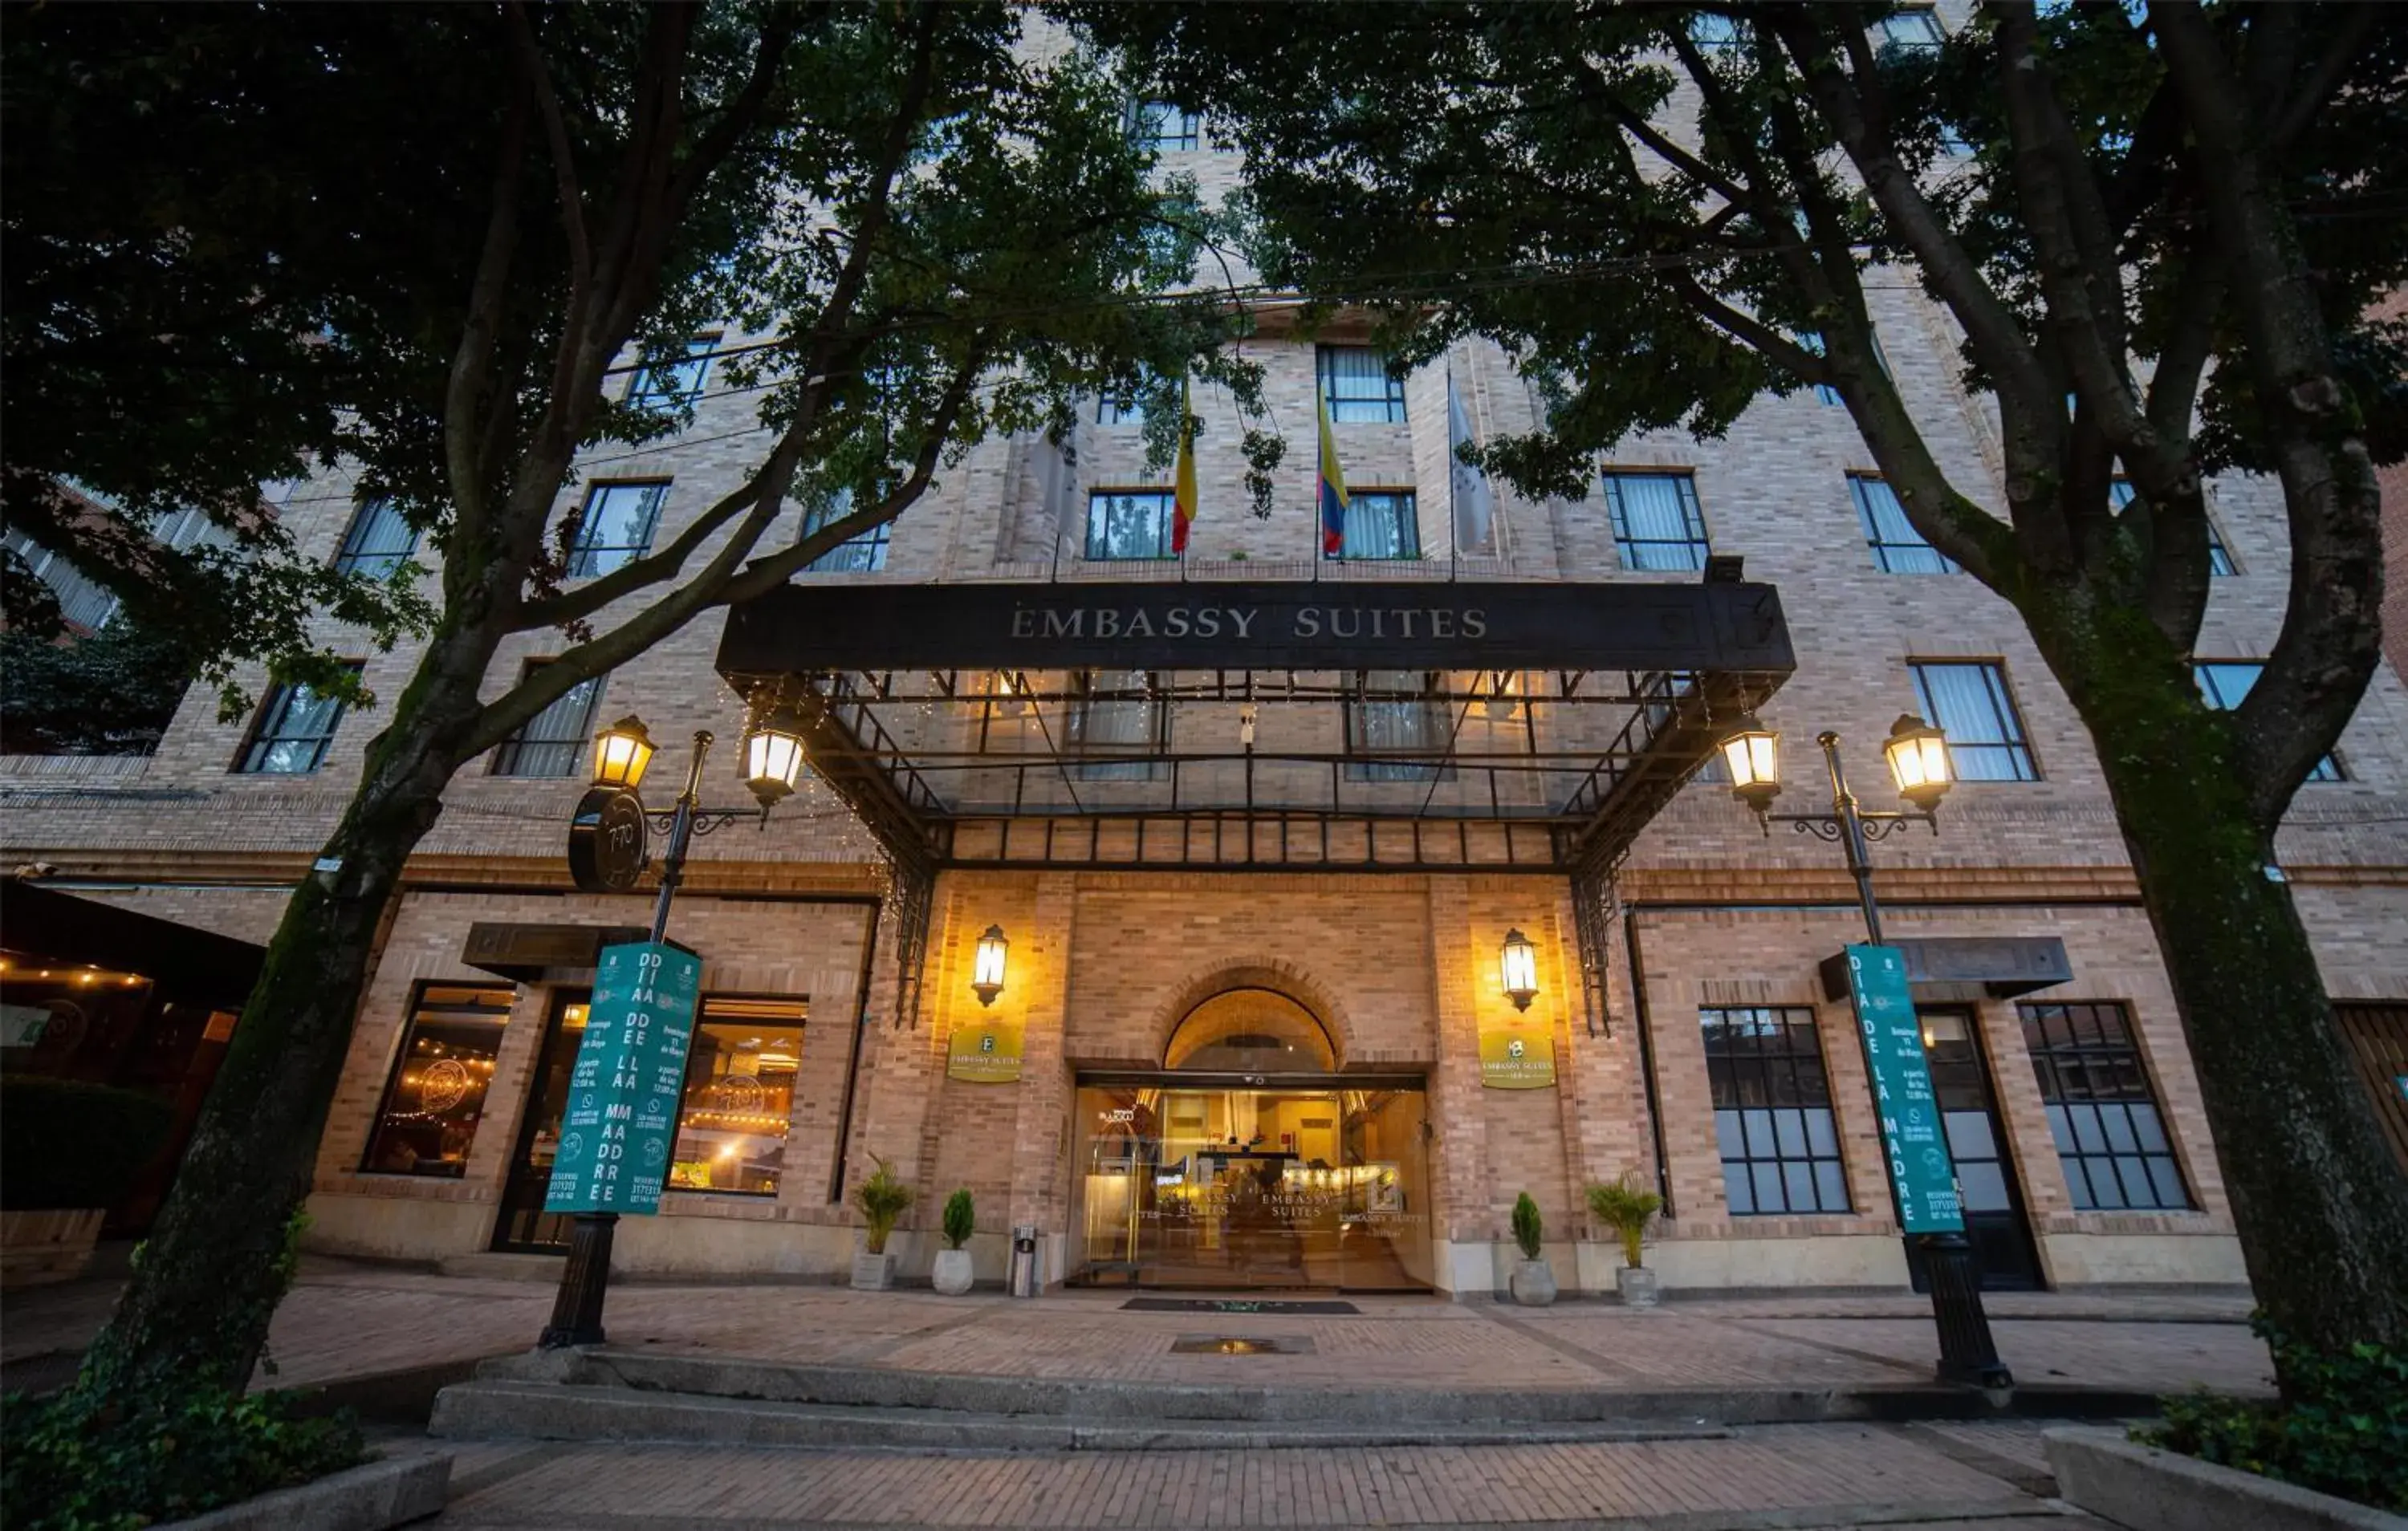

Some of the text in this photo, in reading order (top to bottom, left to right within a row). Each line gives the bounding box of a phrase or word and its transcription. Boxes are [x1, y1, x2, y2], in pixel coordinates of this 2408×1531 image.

[1011, 607, 1487, 639] EMBASSY SUITES
[624, 1013, 638, 1045] DE
[636, 1013, 649, 1046] DE
[612, 1055, 626, 1088] LA
[625, 1056, 638, 1089] LA
[1863, 1020, 1880, 1054] DE
[1875, 1065, 1890, 1101] LA
[1883, 1117, 1914, 1221] MADRE
[589, 1104, 619, 1200] MADRE
[603, 1105, 632, 1202] MADRE
